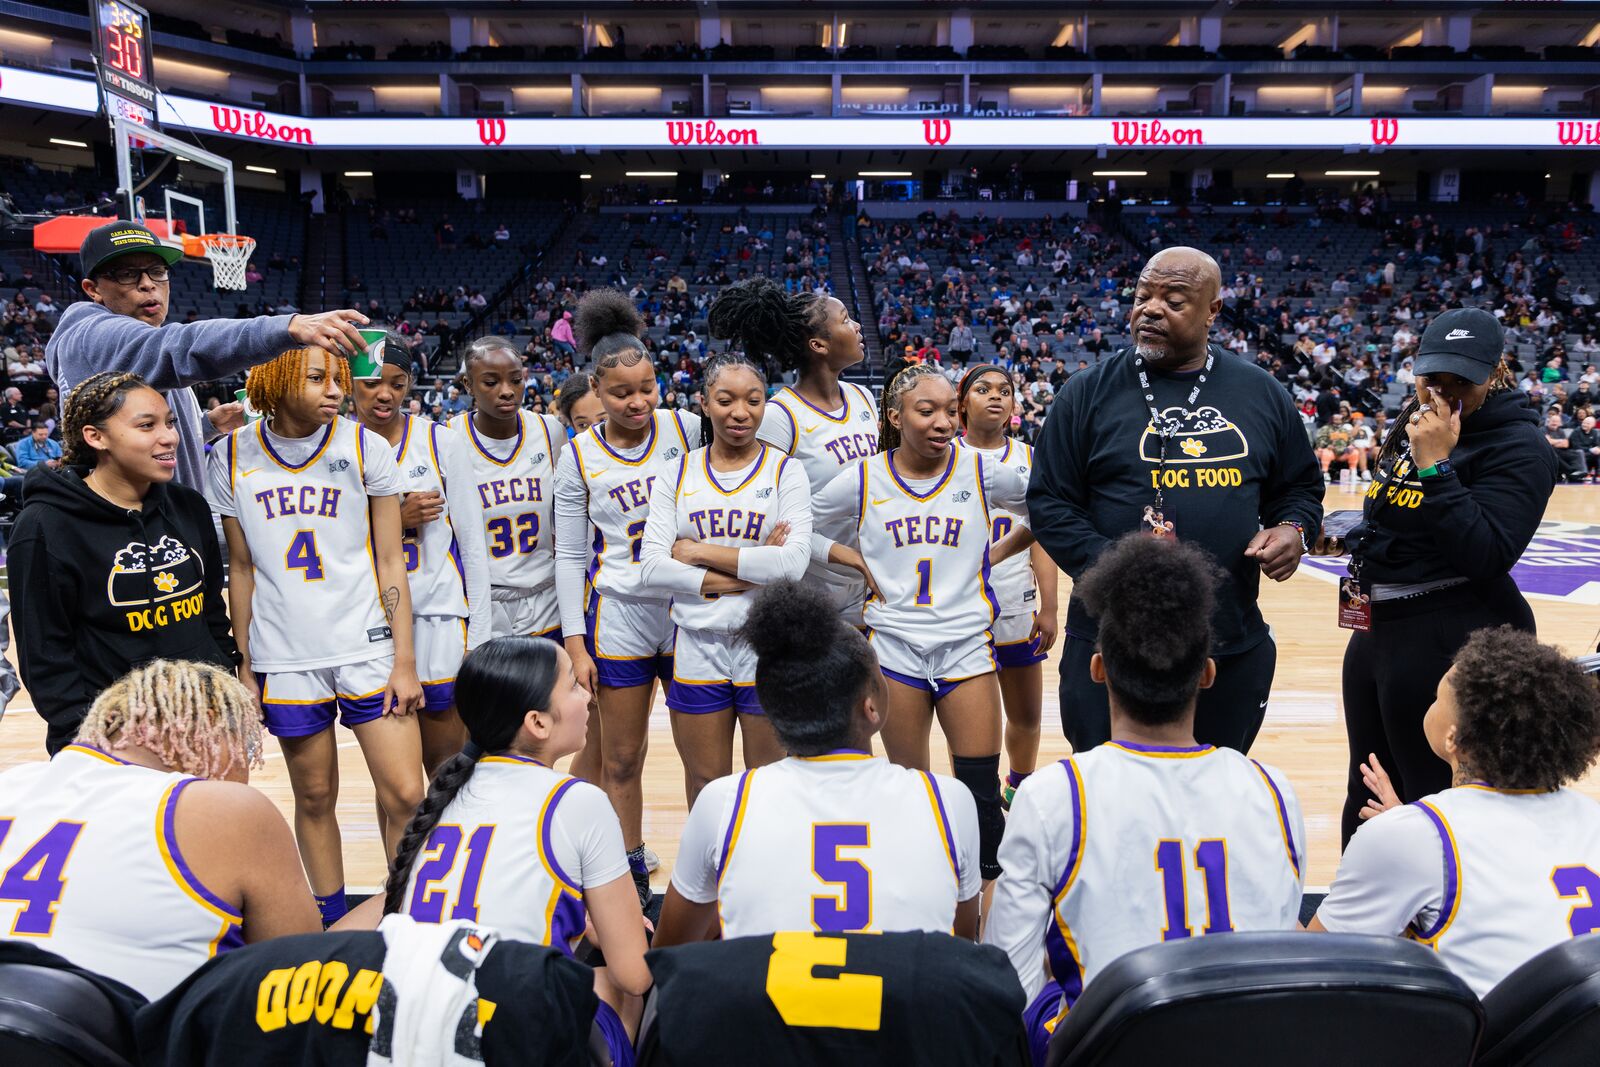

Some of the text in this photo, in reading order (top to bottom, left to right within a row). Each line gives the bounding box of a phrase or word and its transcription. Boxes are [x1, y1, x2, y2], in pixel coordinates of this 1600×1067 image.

[109, 1, 143, 39] 3:55
[107, 25, 142, 78] 30
[120, 76, 155, 102] TISSOT
[209, 105, 314, 145] Wilson
[477, 118, 506, 146] W
[666, 119, 759, 146] Wilson
[922, 118, 951, 146] W
[1112, 119, 1204, 146] Wilson
[1371, 118, 1398, 145] W
[1450, 328, 1470, 337] NIKE
[824, 432, 879, 466] TECH
[477, 476, 544, 510] TECH
[607, 475, 657, 514] TE
[1150, 467, 1243, 489] DOG FOOD
[254, 486, 342, 520] TECH
[486, 511, 541, 561] 32
[689, 507, 768, 542] TECH
[884, 515, 964, 549] TECH
[285, 528, 326, 583] 4
[914, 557, 935, 607] 1
[0, 816, 88, 938] 4
[408, 823, 498, 924] 21
[810, 821, 872, 931] 5
[1154, 837, 1234, 941] 11
